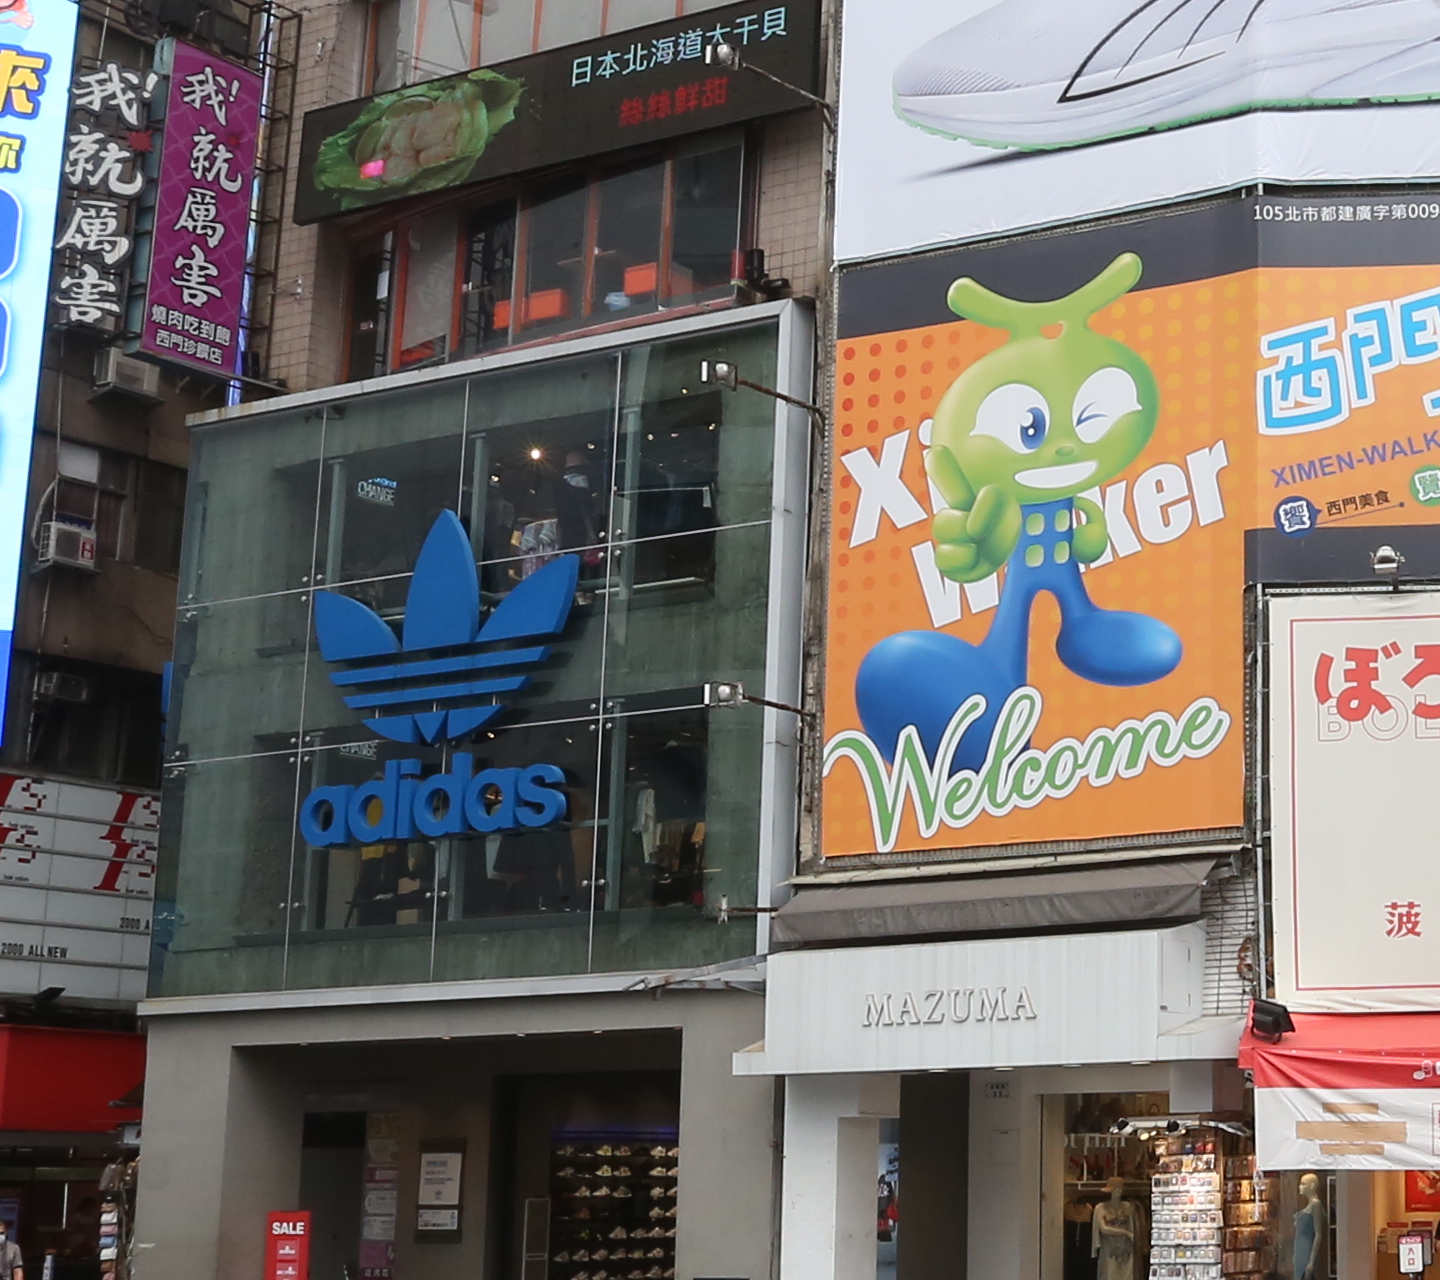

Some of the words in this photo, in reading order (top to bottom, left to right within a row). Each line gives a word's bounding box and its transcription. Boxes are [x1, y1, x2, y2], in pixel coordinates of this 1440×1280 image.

[572, 6, 787, 87] 日本北海道大干貝
[150, 304, 232, 347] 燒肉吃到飽
[1324, 489, 1390, 517] 西門美食
[825, 684, 1229, 854] Welcome
[299, 752, 567, 848] adidas
[1, 942, 24, 957] 2000
[28, 944, 47, 958] ALL
[47, 946, 68, 959] NEW
[862, 986, 1037, 1027] MAZUMA
[271, 1221, 305, 1235] SALE
